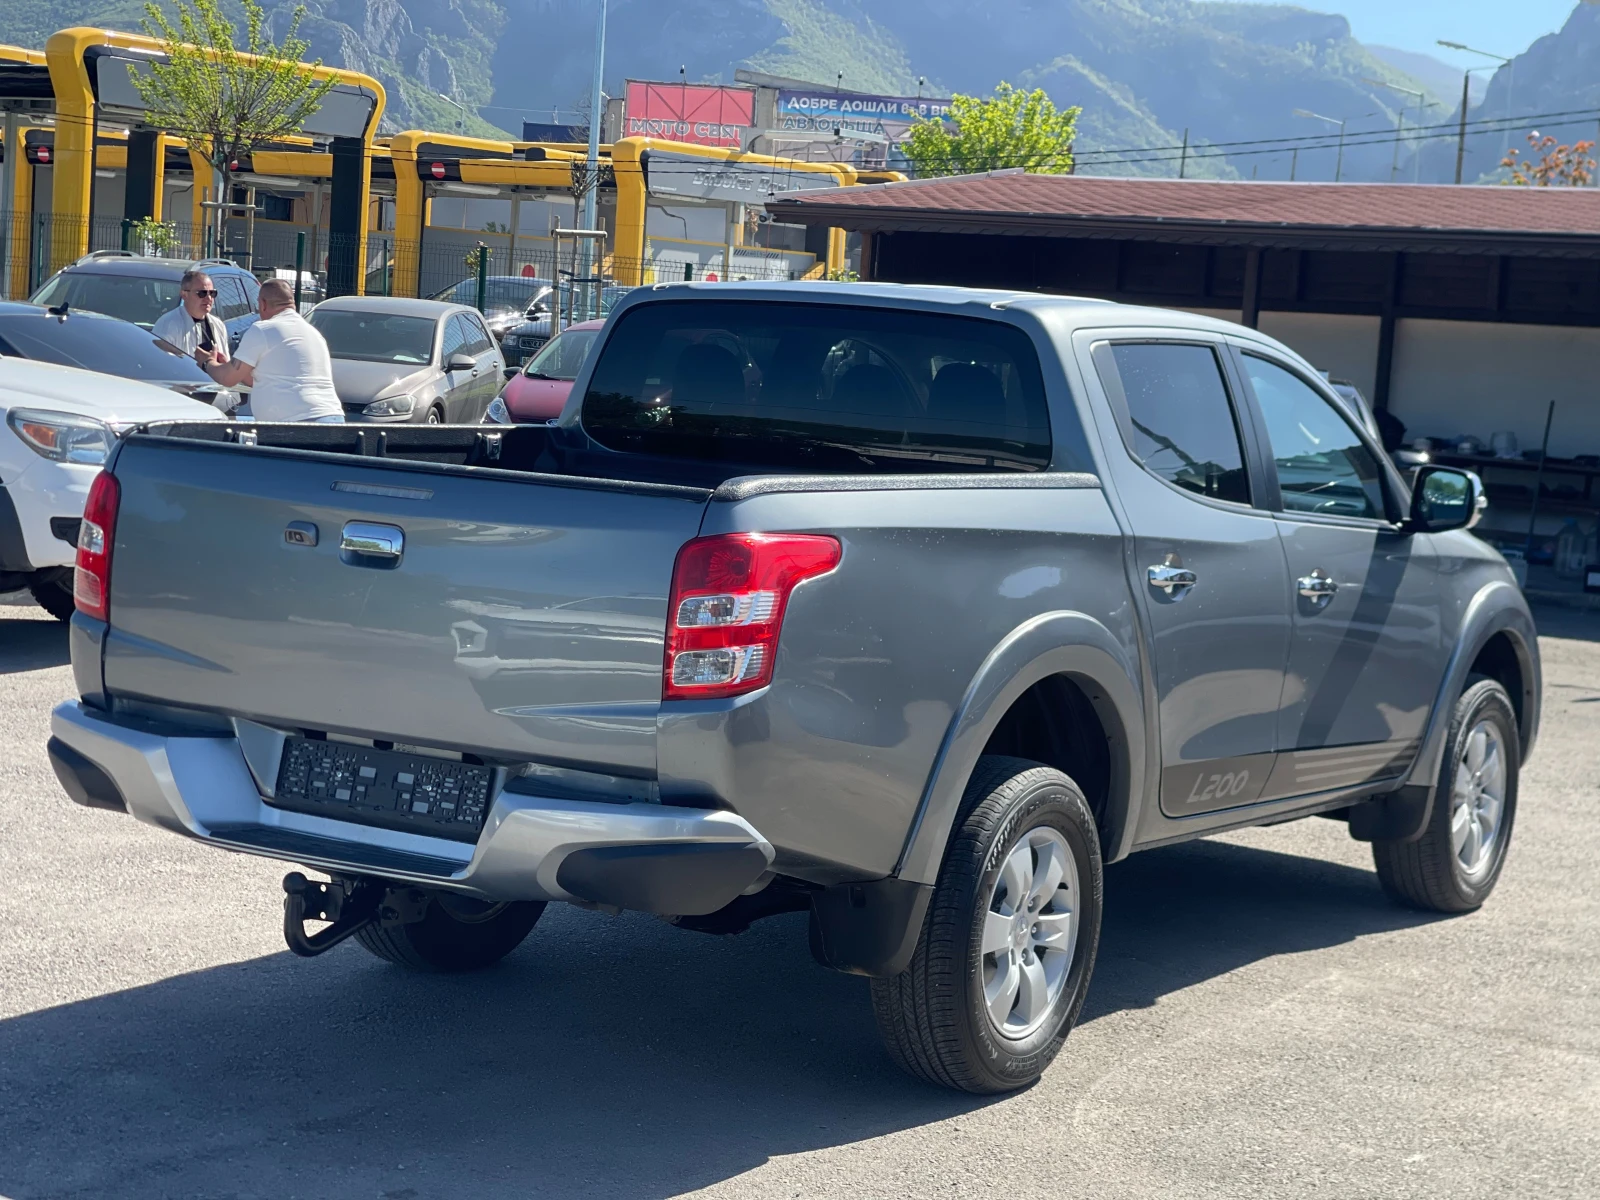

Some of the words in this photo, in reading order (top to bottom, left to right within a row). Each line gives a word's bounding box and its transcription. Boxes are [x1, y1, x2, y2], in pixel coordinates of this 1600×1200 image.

[787, 96, 838, 110] ДОБРЕ
[840, 99, 898, 114] ДОШЛИ
[630, 117, 690, 135] МОТО
[782, 115, 886, 136] АВТОКЪЩА
[1186, 769, 1250, 804] L200
